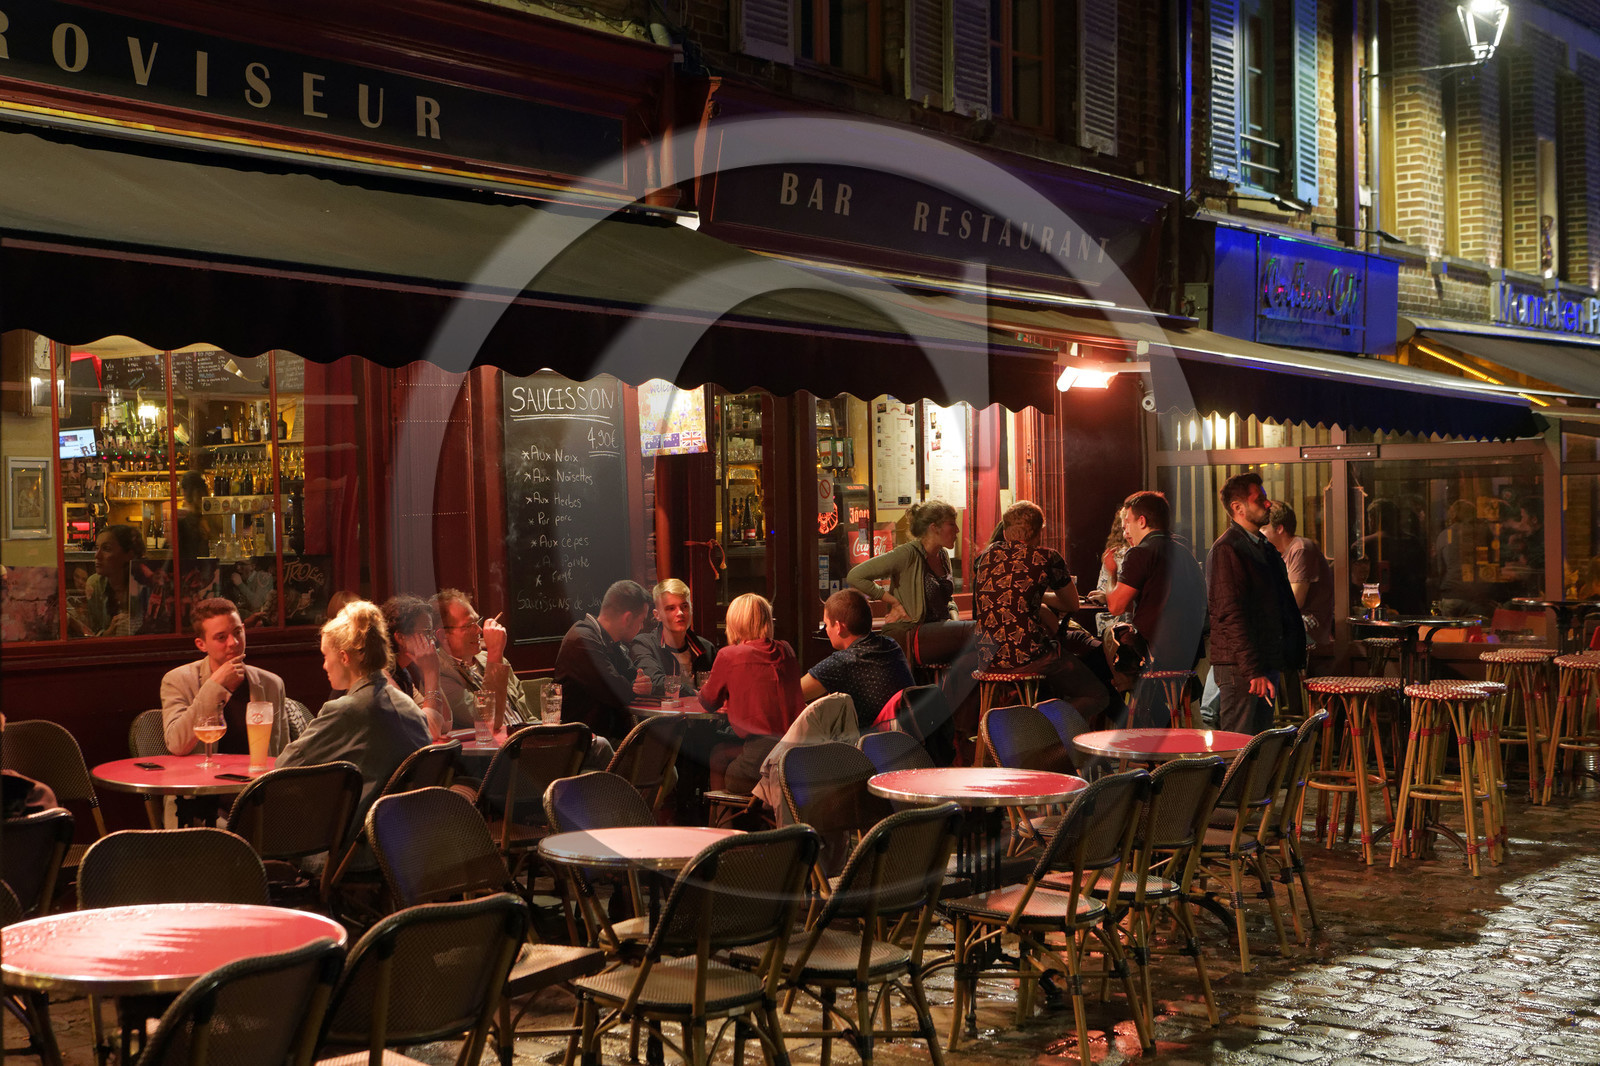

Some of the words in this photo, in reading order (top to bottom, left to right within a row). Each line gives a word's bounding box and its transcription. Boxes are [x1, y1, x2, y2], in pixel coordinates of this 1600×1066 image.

[779, 171, 853, 217] BAR
[913, 200, 1111, 264] RESTAURANT
[509, 386, 615, 413] SAUCISSON
[530, 444, 551, 462] Aux
[555, 448, 579, 463] Noix
[556, 469, 594, 486] Noisettes
[554, 514, 573, 526] porc
[539, 534, 559, 548] Aux
[853, 536, 888, 557] Cocaola
